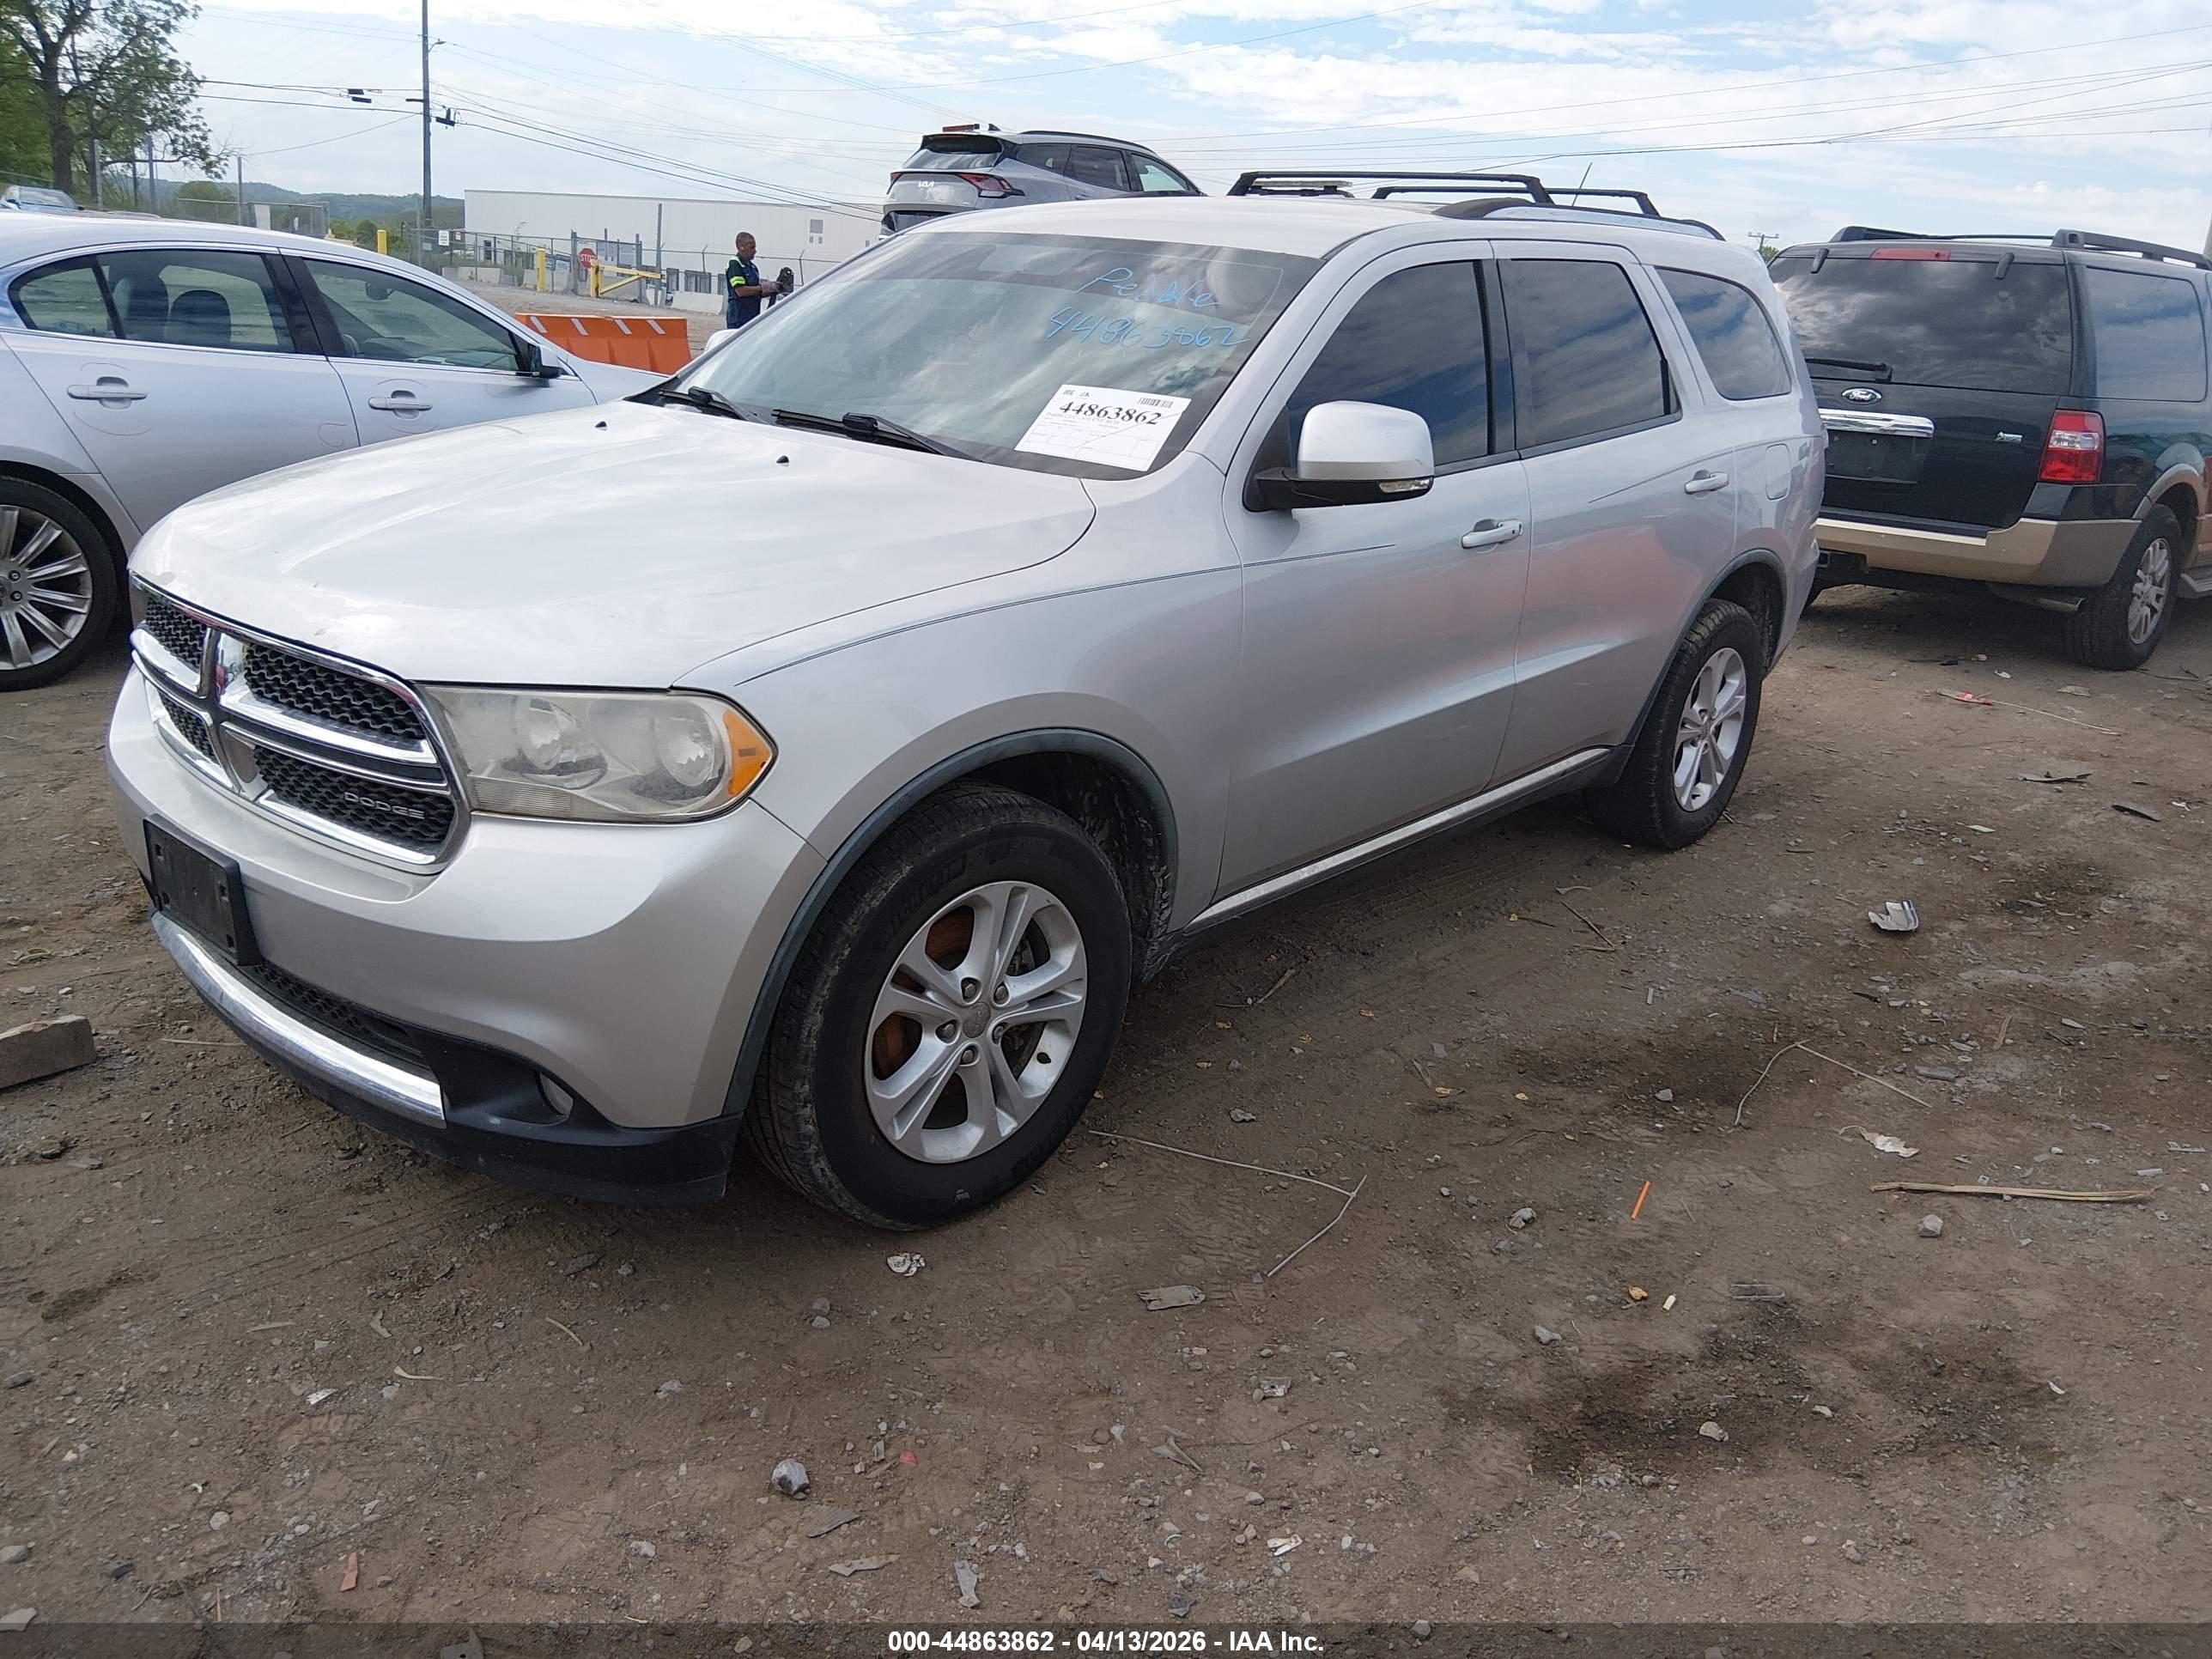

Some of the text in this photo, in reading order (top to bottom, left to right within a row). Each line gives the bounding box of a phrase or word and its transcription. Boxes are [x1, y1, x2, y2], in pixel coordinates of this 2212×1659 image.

[1046, 307, 1250, 349] 44863862
[1059, 400, 1162, 425] 44863862
[344, 791, 425, 819] DODGE
